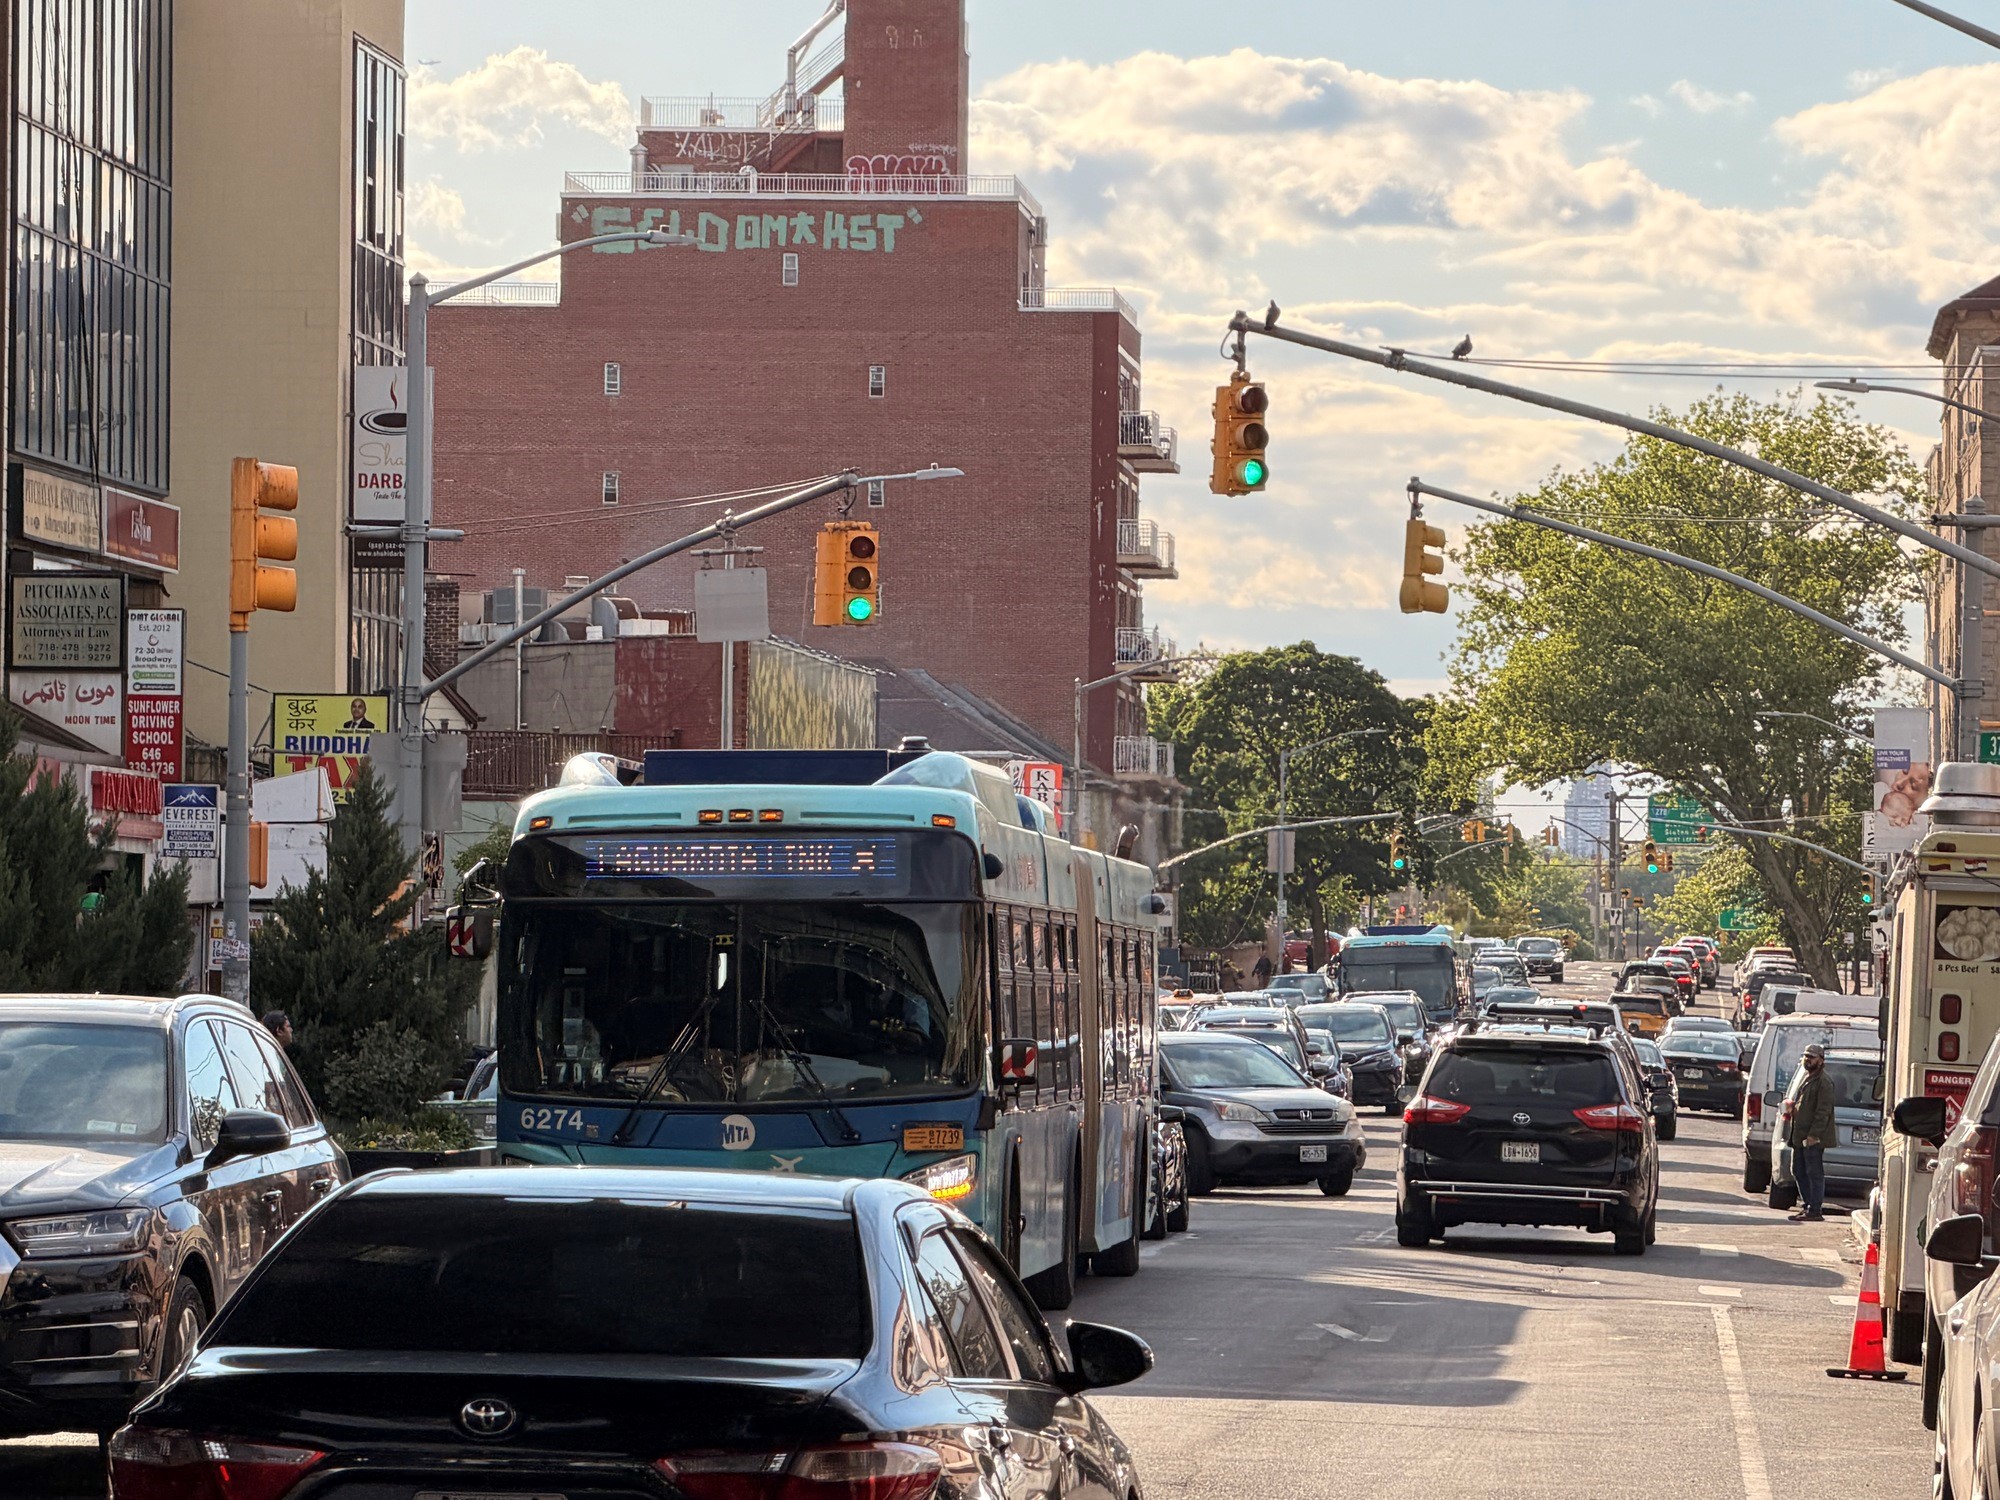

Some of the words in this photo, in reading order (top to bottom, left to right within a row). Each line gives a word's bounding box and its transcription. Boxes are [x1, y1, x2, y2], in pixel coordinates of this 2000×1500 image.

[359, 442, 406, 466] Sha
[24, 585, 97, 599] PITCHAYAN
[101, 585, 110, 599] &
[17, 605, 94, 621] ASSOCIATES,
[97, 605, 117, 620] P.C.
[131, 613, 148, 622] DMT
[150, 613, 180, 622] GLOBAL
[21, 626, 71, 640] Attorneys
[74, 627, 84, 638] at
[88, 627, 110, 638] Law
[153, 624, 171, 632] 2012
[135, 655, 172, 663] Broadway
[128, 700, 180, 714] SUNFLOWER
[65, 715, 90, 725] MOON
[95, 715, 116, 725] TIME
[131, 715, 174, 729] DRIVING
[287, 718, 317, 731] कर
[132, 731, 174, 745] SCHOOL
[142, 748, 161, 760] 646
[166, 808, 215, 821] EVEREST
[1938, 964, 1943, 972] 8
[1945, 964, 1960, 973] Pcs
[1961, 964, 1979, 974] Beef
[1931, 1074, 1972, 1085] DANGER
[521, 1108, 583, 1131] 6274
[722, 1124, 749, 1144] MTA
